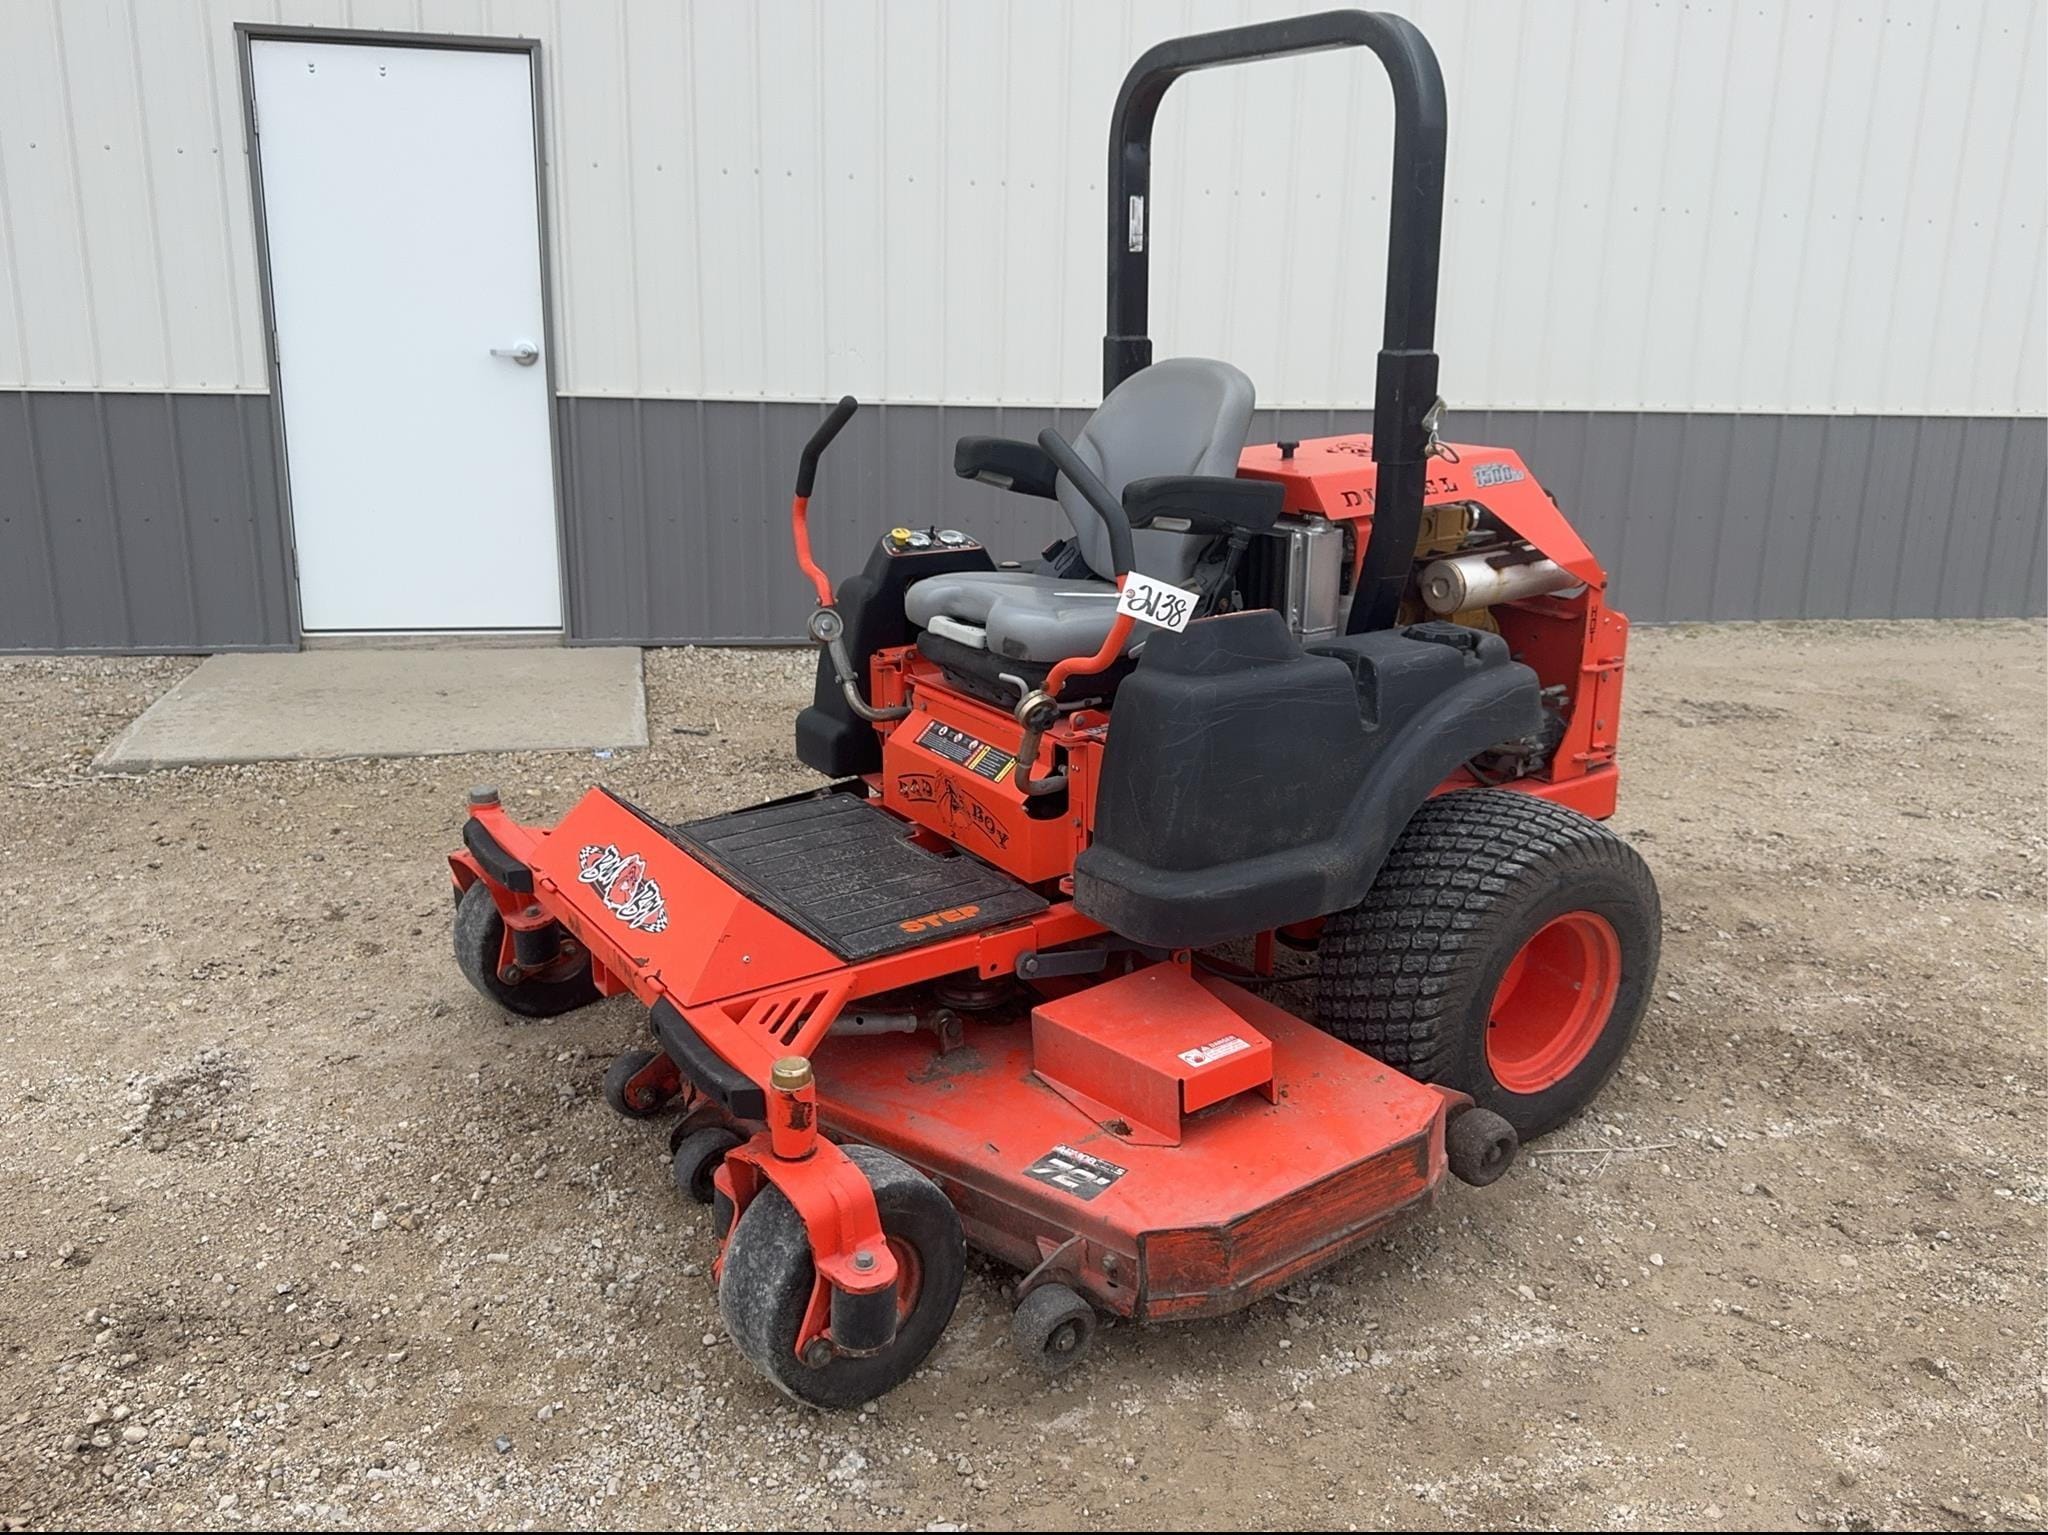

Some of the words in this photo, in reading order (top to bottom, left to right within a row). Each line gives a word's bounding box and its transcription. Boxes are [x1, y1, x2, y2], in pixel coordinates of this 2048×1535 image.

[1127, 584, 1187, 628] 2138
[971, 803, 1010, 849] BOY
[899, 904, 981, 934] STEP
